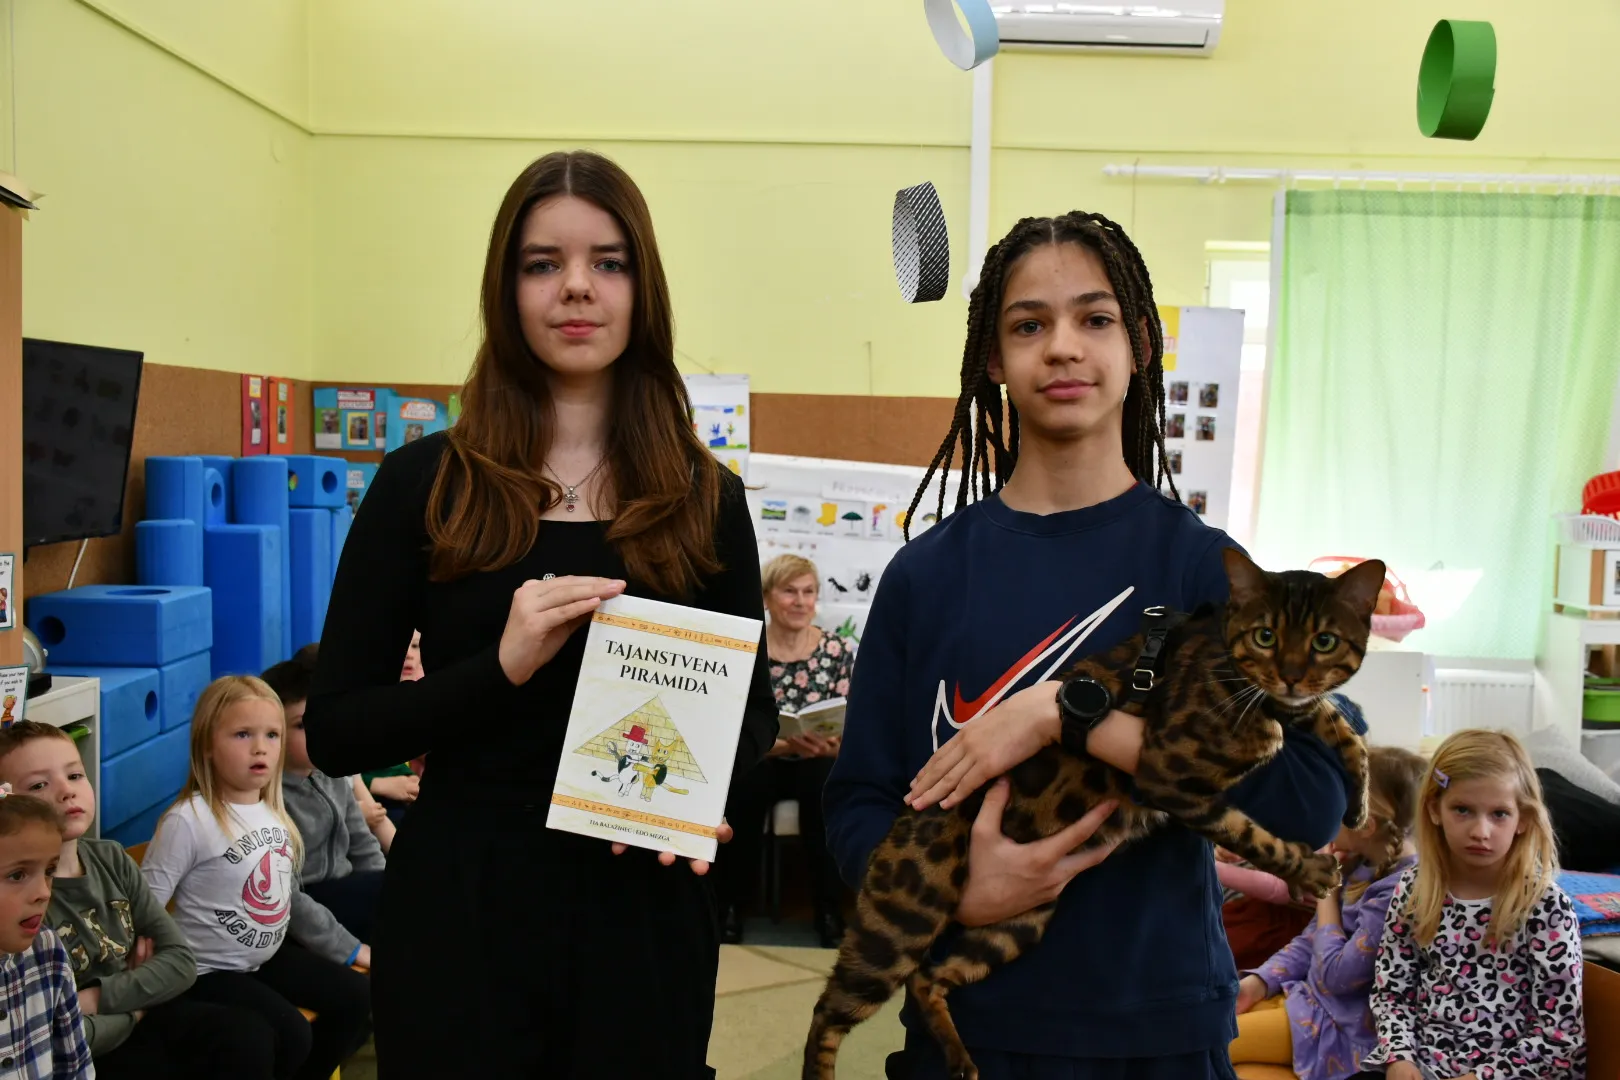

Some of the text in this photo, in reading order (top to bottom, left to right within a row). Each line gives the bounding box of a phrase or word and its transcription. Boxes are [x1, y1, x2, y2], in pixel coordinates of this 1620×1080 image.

[606, 640, 728, 677] TAJANSTVENA
[620, 665, 708, 694] PIRAMIDA
[635, 829, 649, 837] EDO
[649, 832, 670, 841] MEZGA
